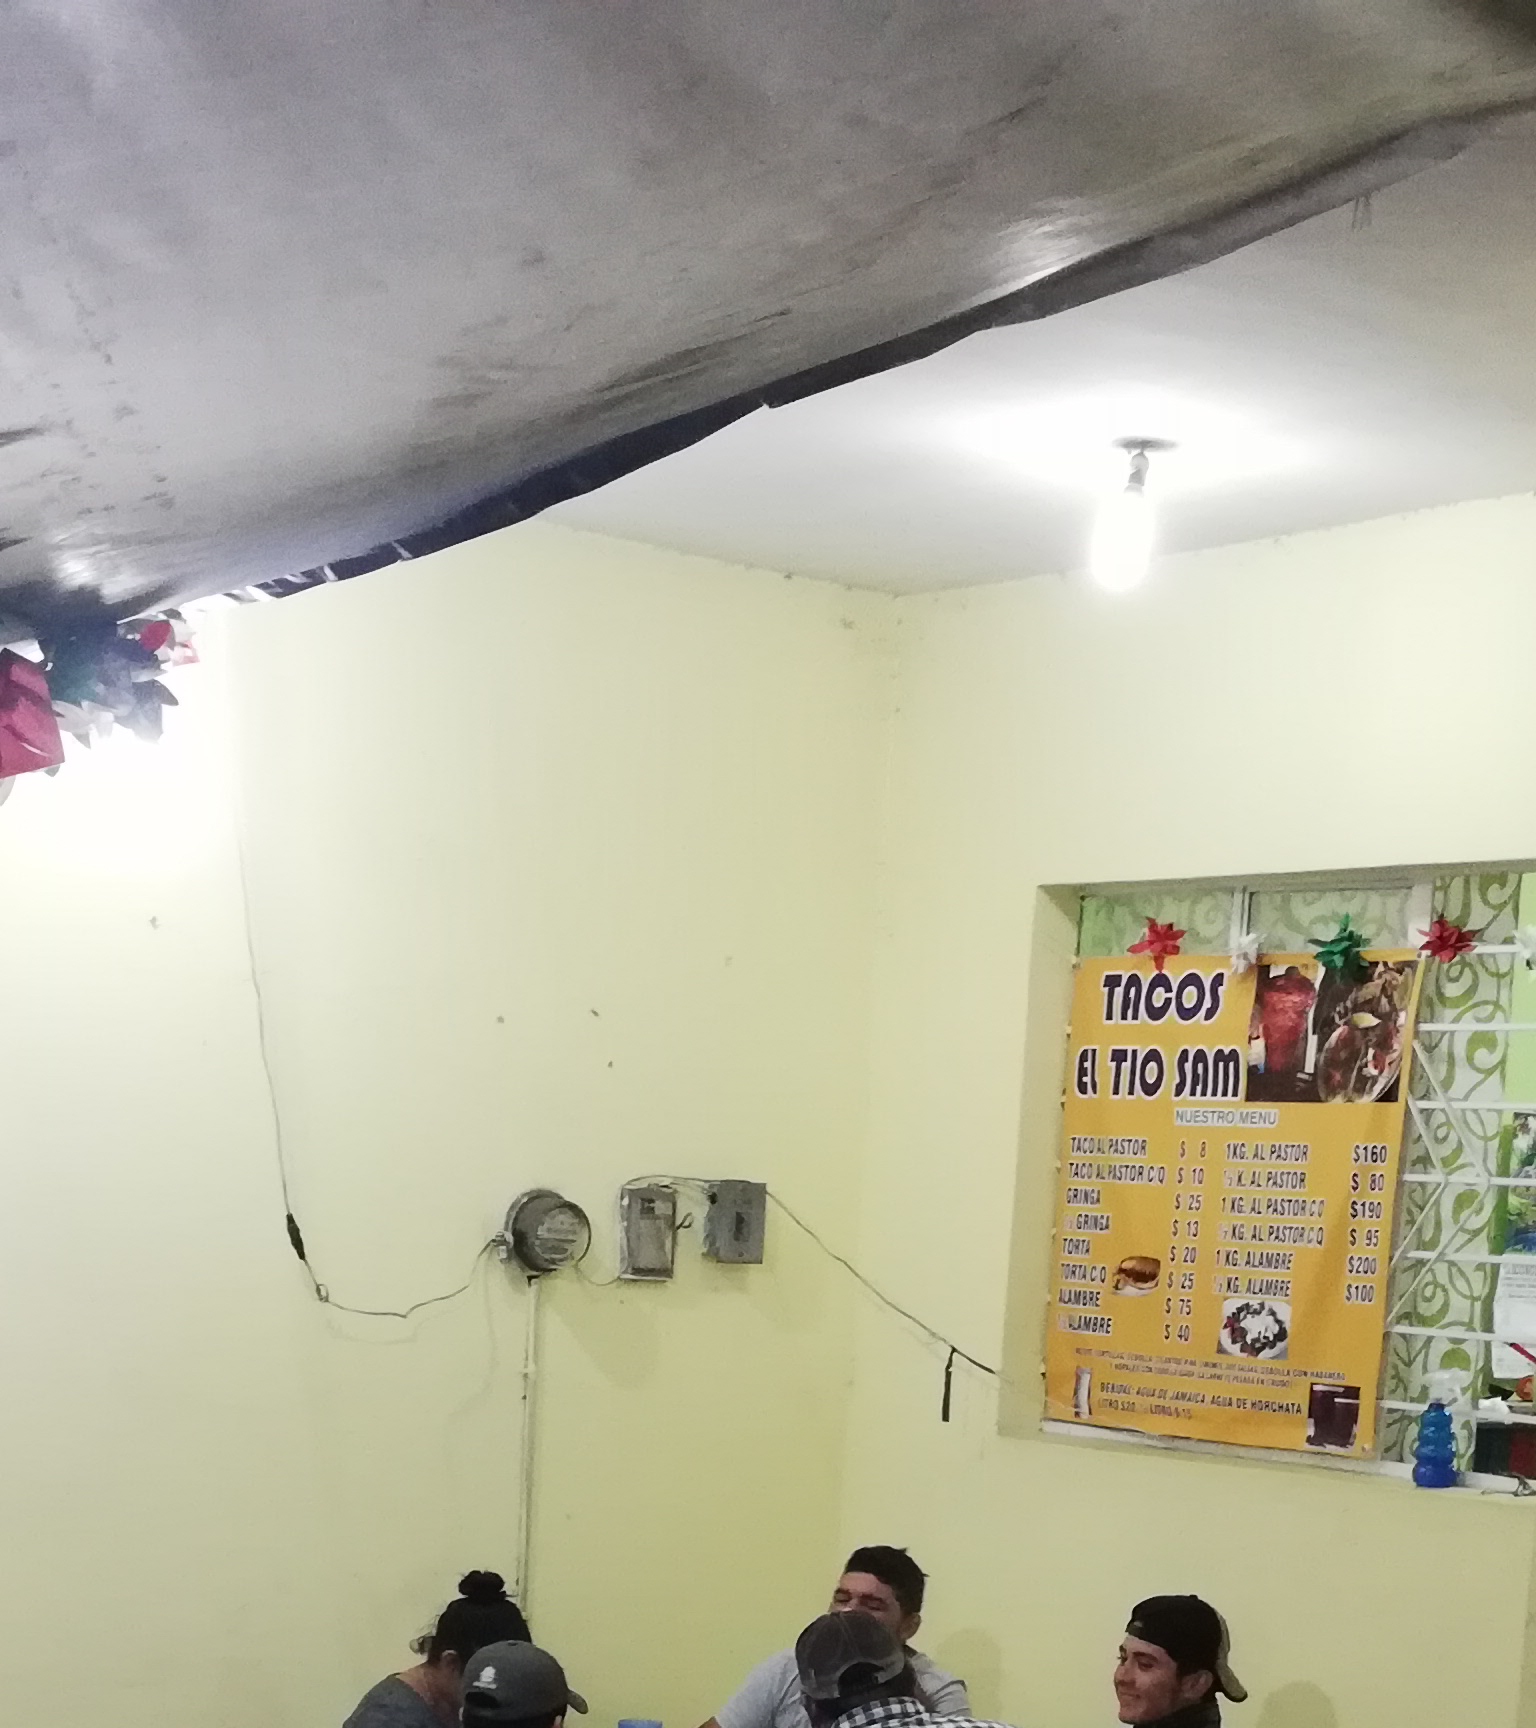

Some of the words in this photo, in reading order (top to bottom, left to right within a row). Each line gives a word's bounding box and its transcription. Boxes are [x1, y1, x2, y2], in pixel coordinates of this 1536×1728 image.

[1103, 972, 1224, 1021] TACOS
[1076, 1048, 1098, 1095] EL
[1110, 1048, 1164, 1097] TIO
[1174, 1048, 1240, 1098] SAM
[1175, 1110, 1235, 1124] NUESTRO
[1238, 1111, 1276, 1125] MENU
[1070, 1137, 1095, 1154] TACO
[1096, 1138, 1105, 1154] AL
[1108, 1138, 1147, 1156] PASTOR
[1252, 1143, 1265, 1161] AL
[1269, 1144, 1308, 1162] PASTOR
[1353, 1145, 1387, 1164] $160
[1068, 1162, 1093, 1179] TACO
[1095, 1164, 1105, 1180] AL
[1107, 1164, 1144, 1182] PASTOR
[1192, 1168, 1204, 1184] 10
[1249, 1170, 1262, 1188] AL
[1266, 1171, 1307, 1189] PASTOR
[1369, 1173, 1385, 1191] 80
[1066, 1187, 1100, 1205] GRINGA
[1188, 1195, 1202, 1211] 25
[1249, 1197, 1262, 1214] AL
[1266, 1198, 1306, 1216] PASTOR
[1350, 1200, 1382, 1219] $190
[1076, 1213, 1110, 1231] GRINGA
[1186, 1220, 1200, 1238] 13
[1251, 1224, 1264, 1242] AL
[1267, 1225, 1304, 1244] PASTOR
[1365, 1229, 1380, 1247] 95
[1062, 1237, 1091, 1256] TORTA
[1183, 1246, 1197, 1264] 20
[1245, 1251, 1294, 1271] ALAMBRE
[1348, 1255, 1377, 1275] $200
[1060, 1263, 1087, 1281] TORTA
[1180, 1272, 1195, 1290] 25
[1245, 1278, 1291, 1297] ALAMBRE
[1346, 1283, 1375, 1303] $100
[1058, 1288, 1101, 1307] ALAMBRE
[1179, 1299, 1192, 1316] 75
[1177, 1324, 1190, 1342] 40
[1236, 1397, 1248, 1409] DE
[1251, 1399, 1302, 1414] HORCHATA
